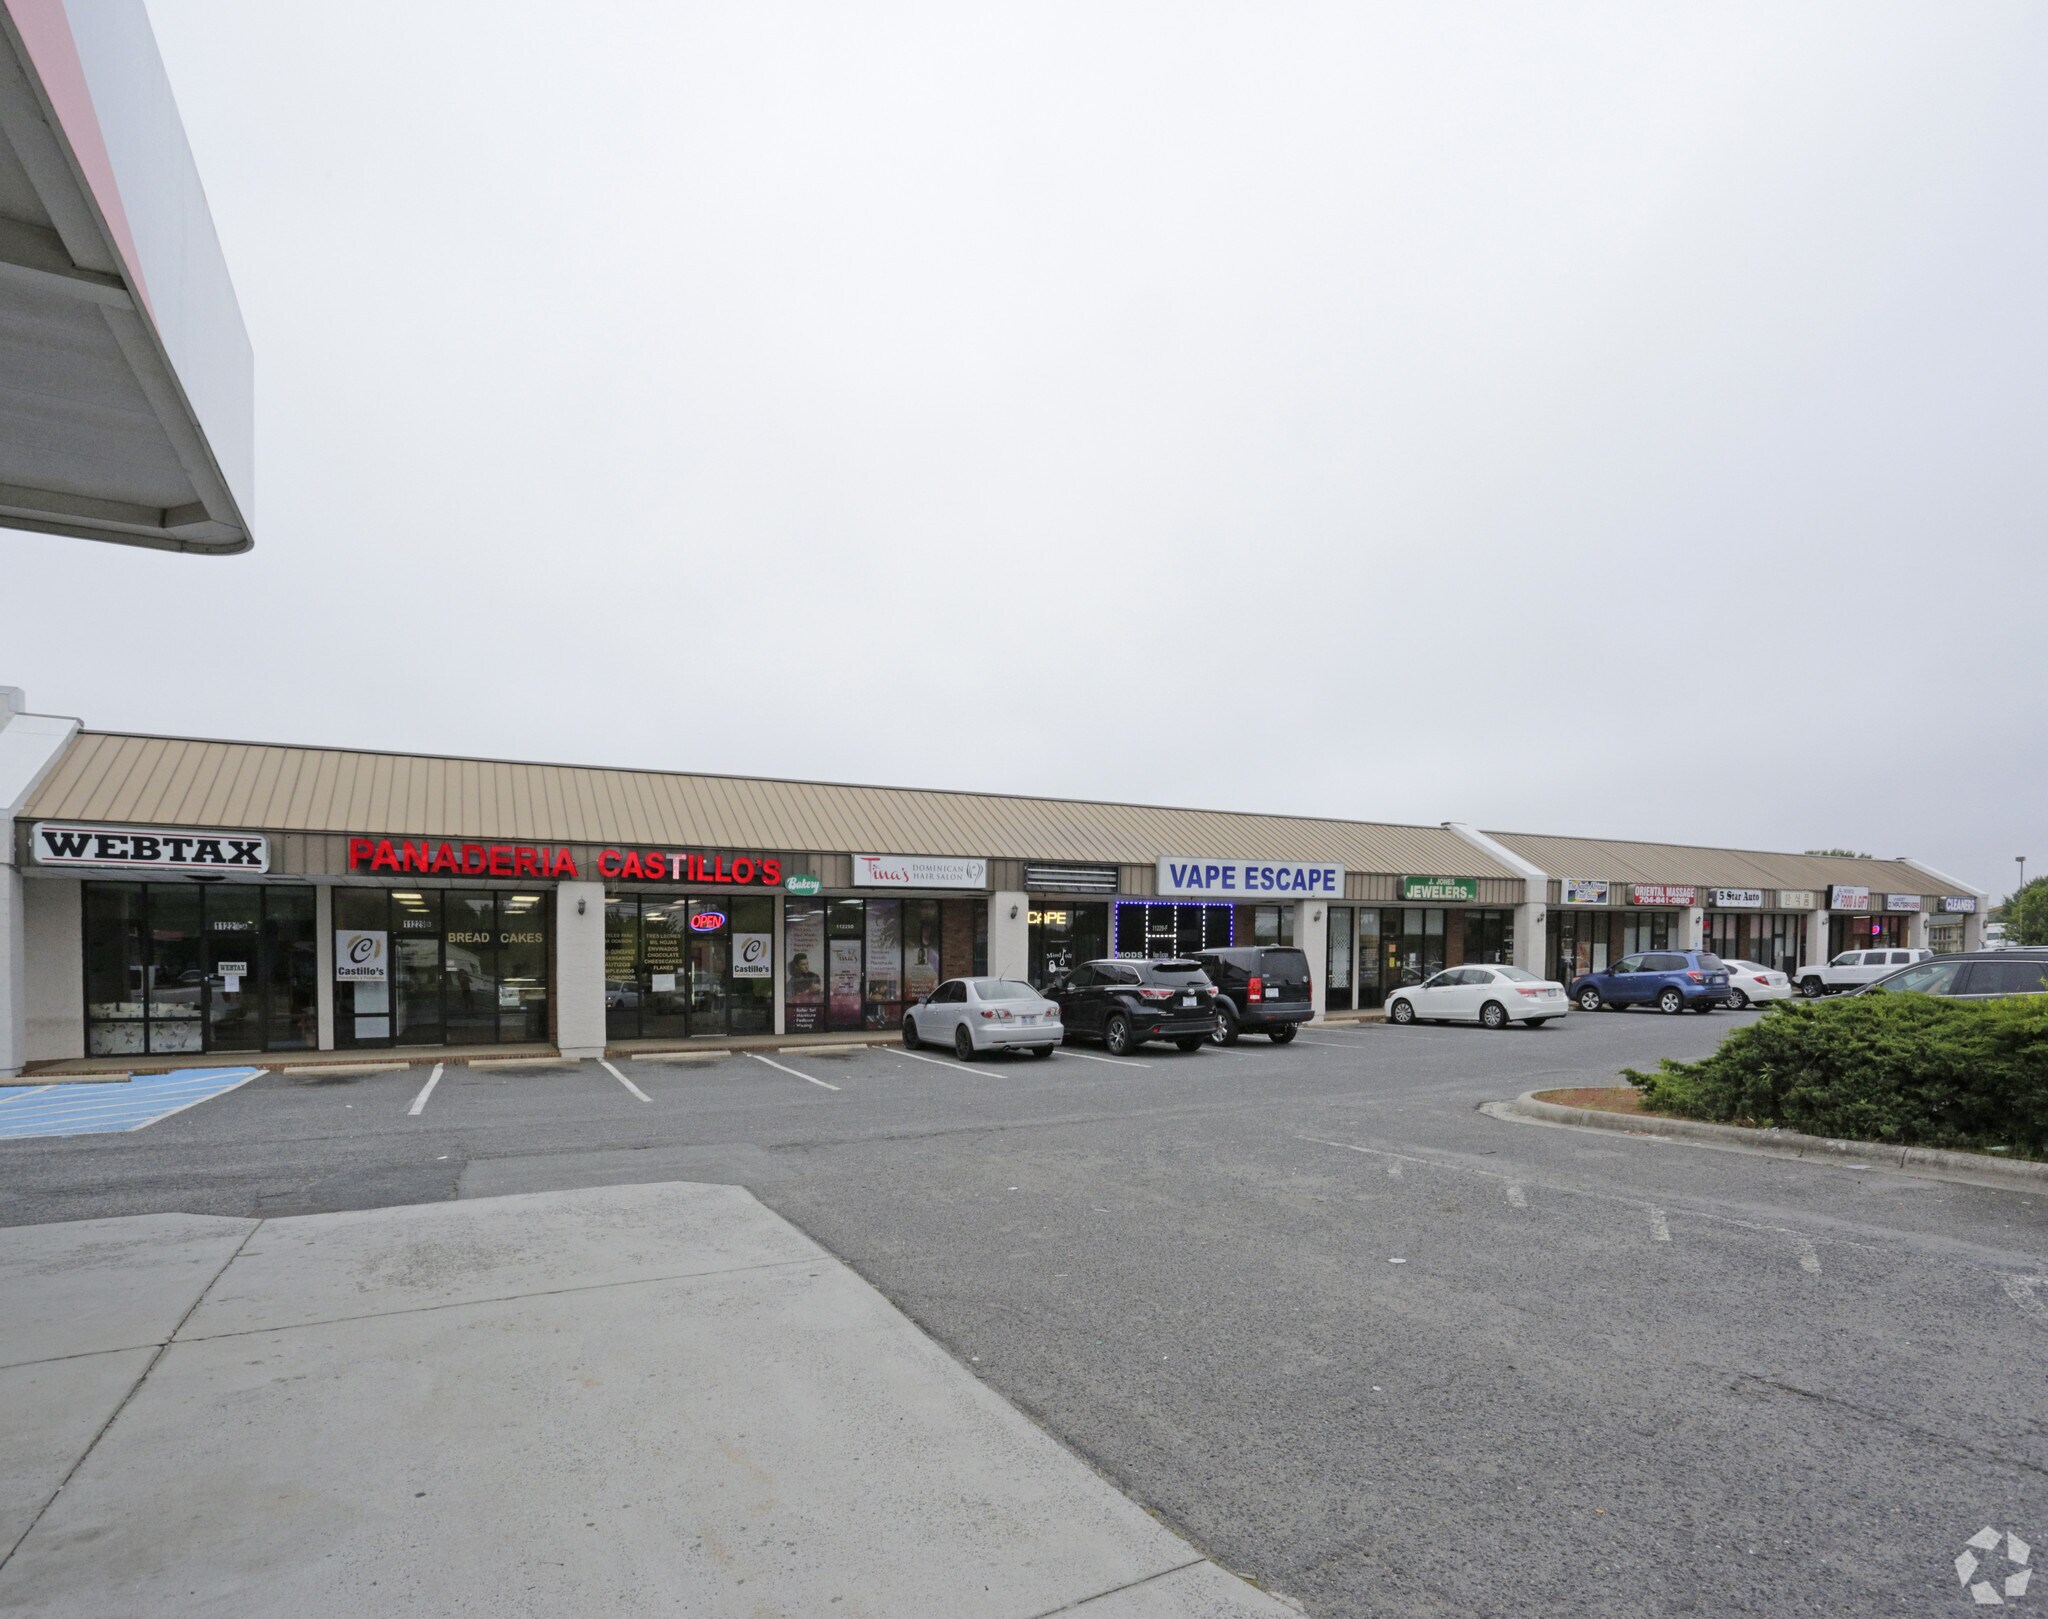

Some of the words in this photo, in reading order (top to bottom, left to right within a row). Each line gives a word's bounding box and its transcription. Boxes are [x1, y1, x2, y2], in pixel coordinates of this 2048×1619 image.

[42, 831, 262, 865] WEBTAX
[349, 838, 579, 877] PANADERIA
[597, 850, 782, 886] CASTILLO'S
[912, 864, 964, 872] DOMINICAN
[860, 857, 910, 882] Tina's
[1170, 864, 1236, 890] VAPE
[1245, 867, 1336, 891] ESCAPE
[1436, 878, 1456, 886] JONES
[787, 877, 820, 894] Bakery
[1406, 885, 1468, 899] JEWELERS
[1634, 885, 1665, 897] ORIENTAL
[1666, 886, 1695, 898] MASSAGE
[1718, 891, 1725, 900] 5
[1726, 891, 1742, 901] Star
[1743, 892, 1760, 901] Auto
[1841, 895, 1853, 908] FOOD
[1858, 896, 1868, 908] GIFT
[1946, 898, 1975, 912] CLEANERS
[691, 914, 722, 928] OPEN
[448, 932, 490, 943] BREAD
[500, 933, 543, 943] CAKES
[338, 967, 384, 976] Castillo's
[734, 965, 770, 973] Castillo's
